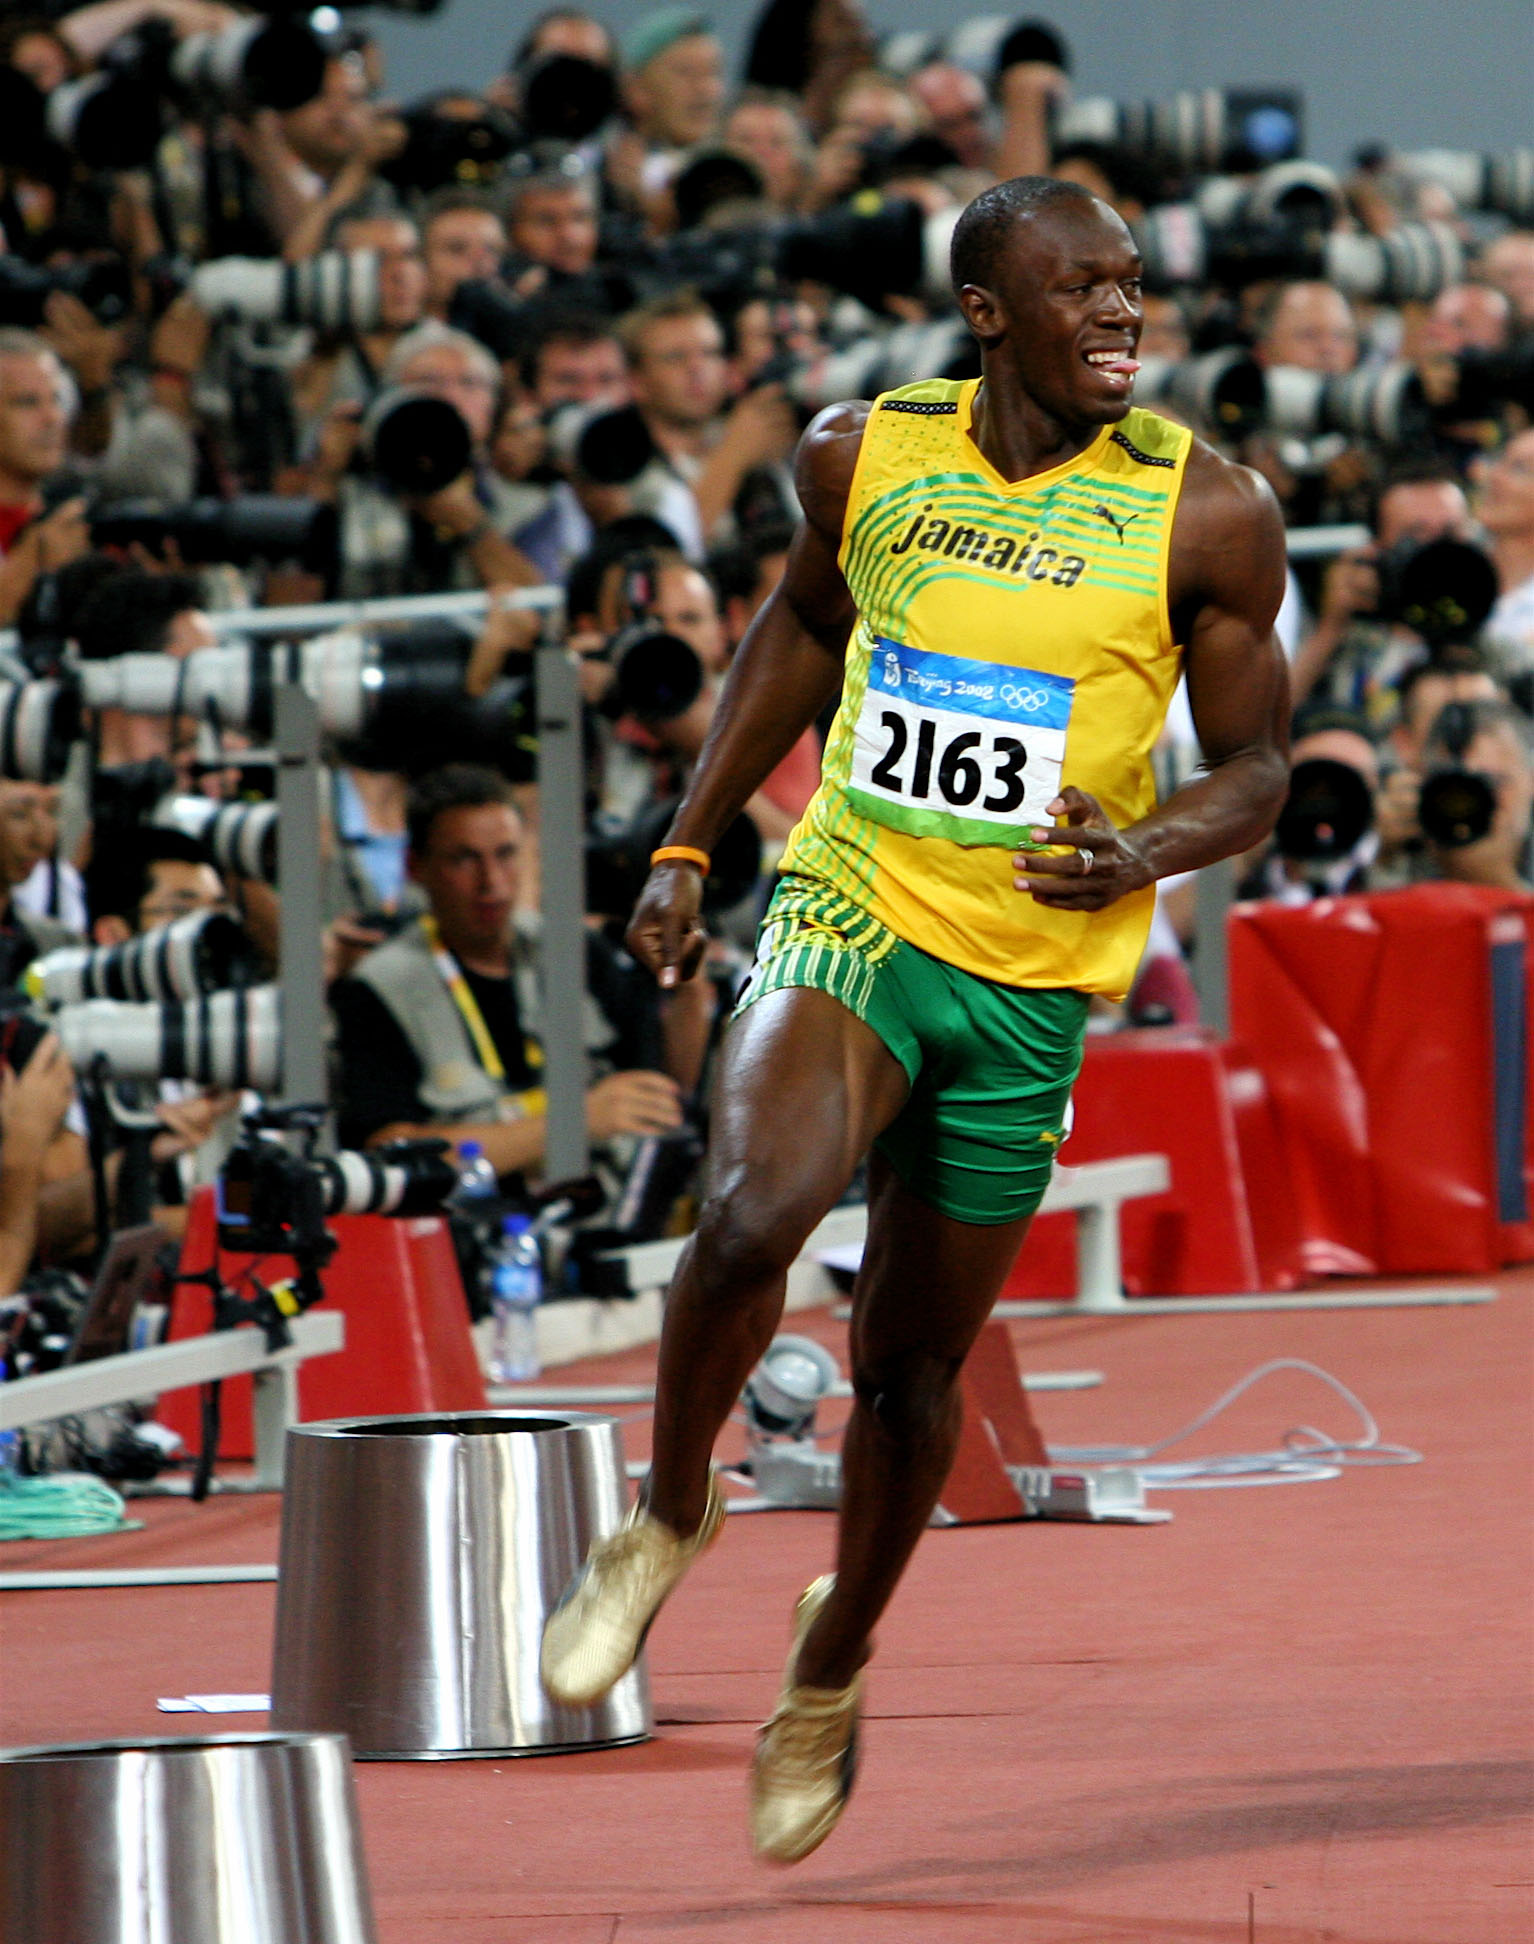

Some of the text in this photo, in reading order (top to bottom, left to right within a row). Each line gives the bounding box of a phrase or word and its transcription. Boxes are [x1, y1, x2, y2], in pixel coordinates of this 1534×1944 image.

[890, 503, 1086, 588] jamaica
[904, 667, 996, 700] Beijing 2008
[871, 711, 1028, 813] 2163
